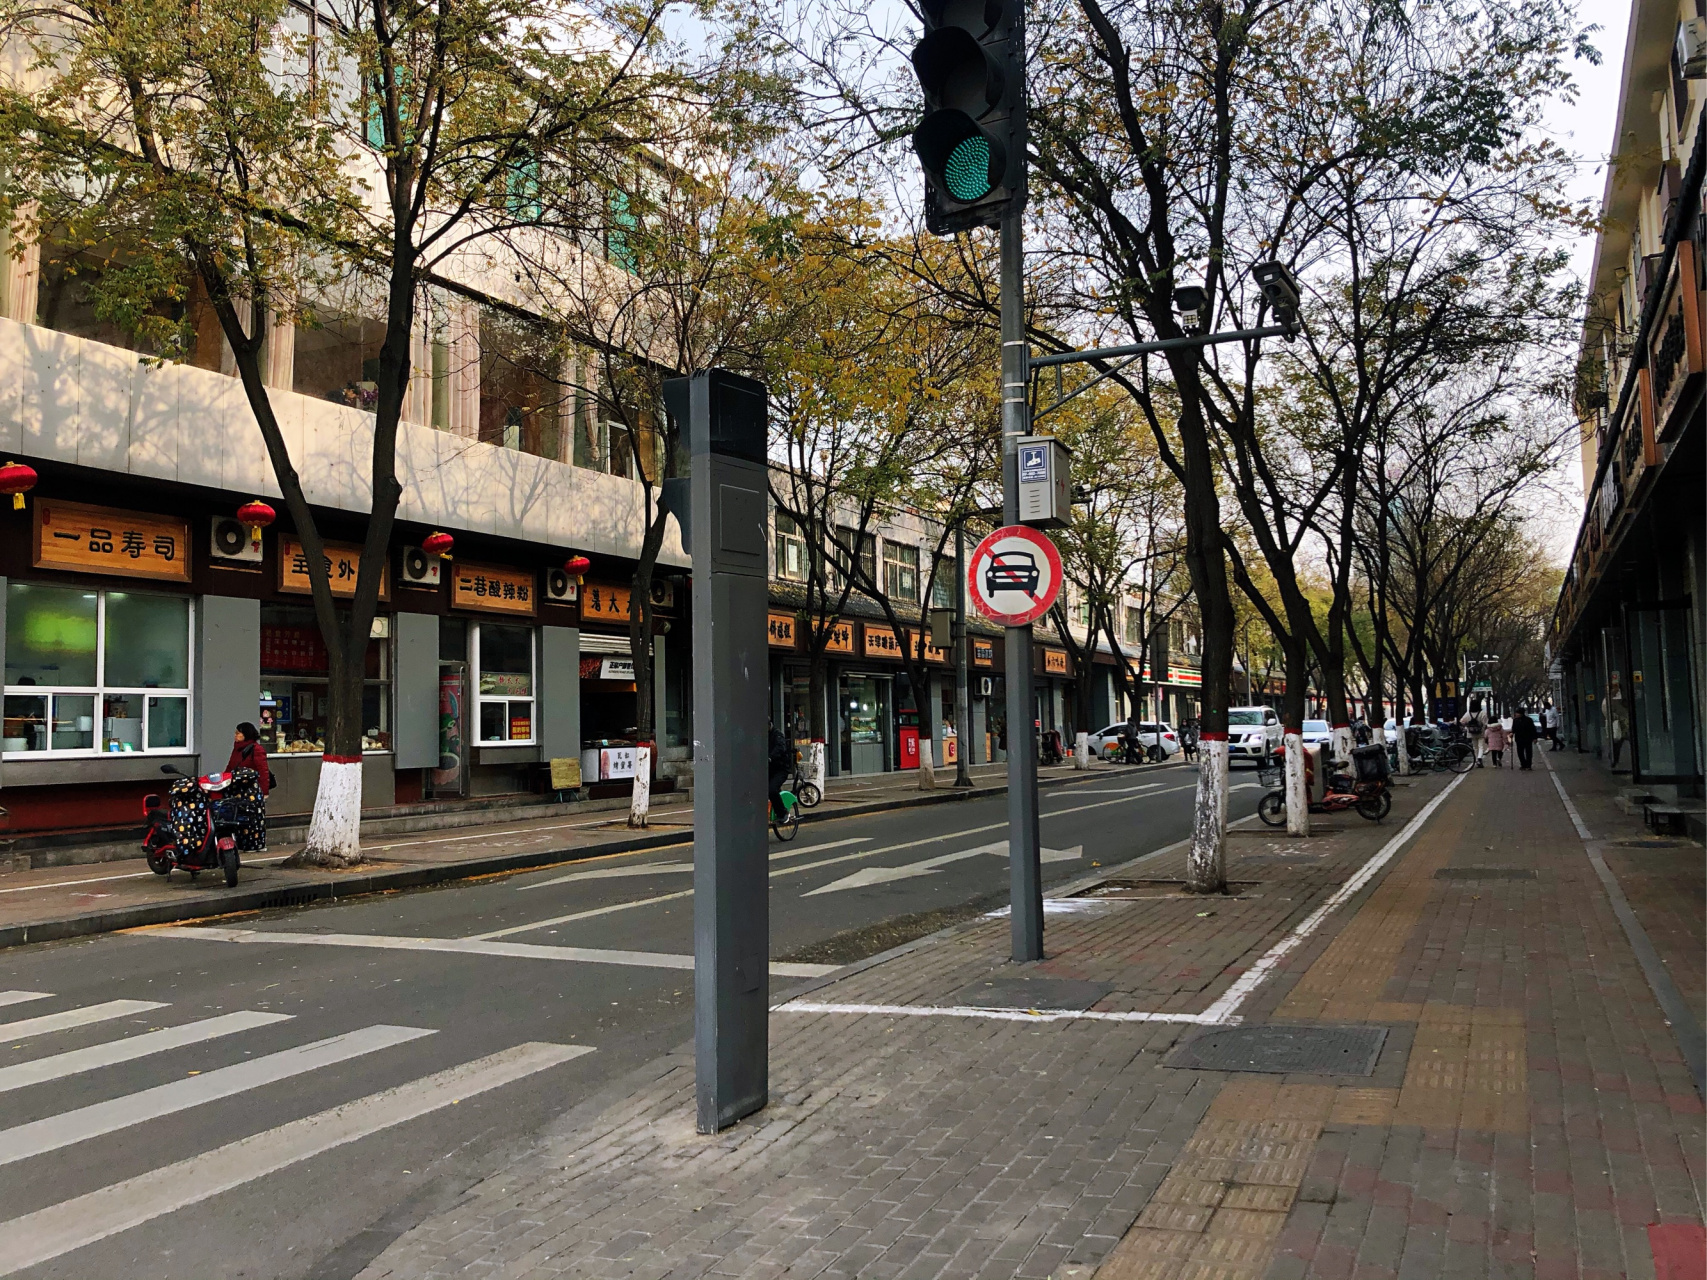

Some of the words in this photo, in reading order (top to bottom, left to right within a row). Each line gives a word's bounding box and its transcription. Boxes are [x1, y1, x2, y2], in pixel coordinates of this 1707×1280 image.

[54, 527, 175, 561] 一品寿司
[459, 575, 529, 602] 二巷酸辣粉
